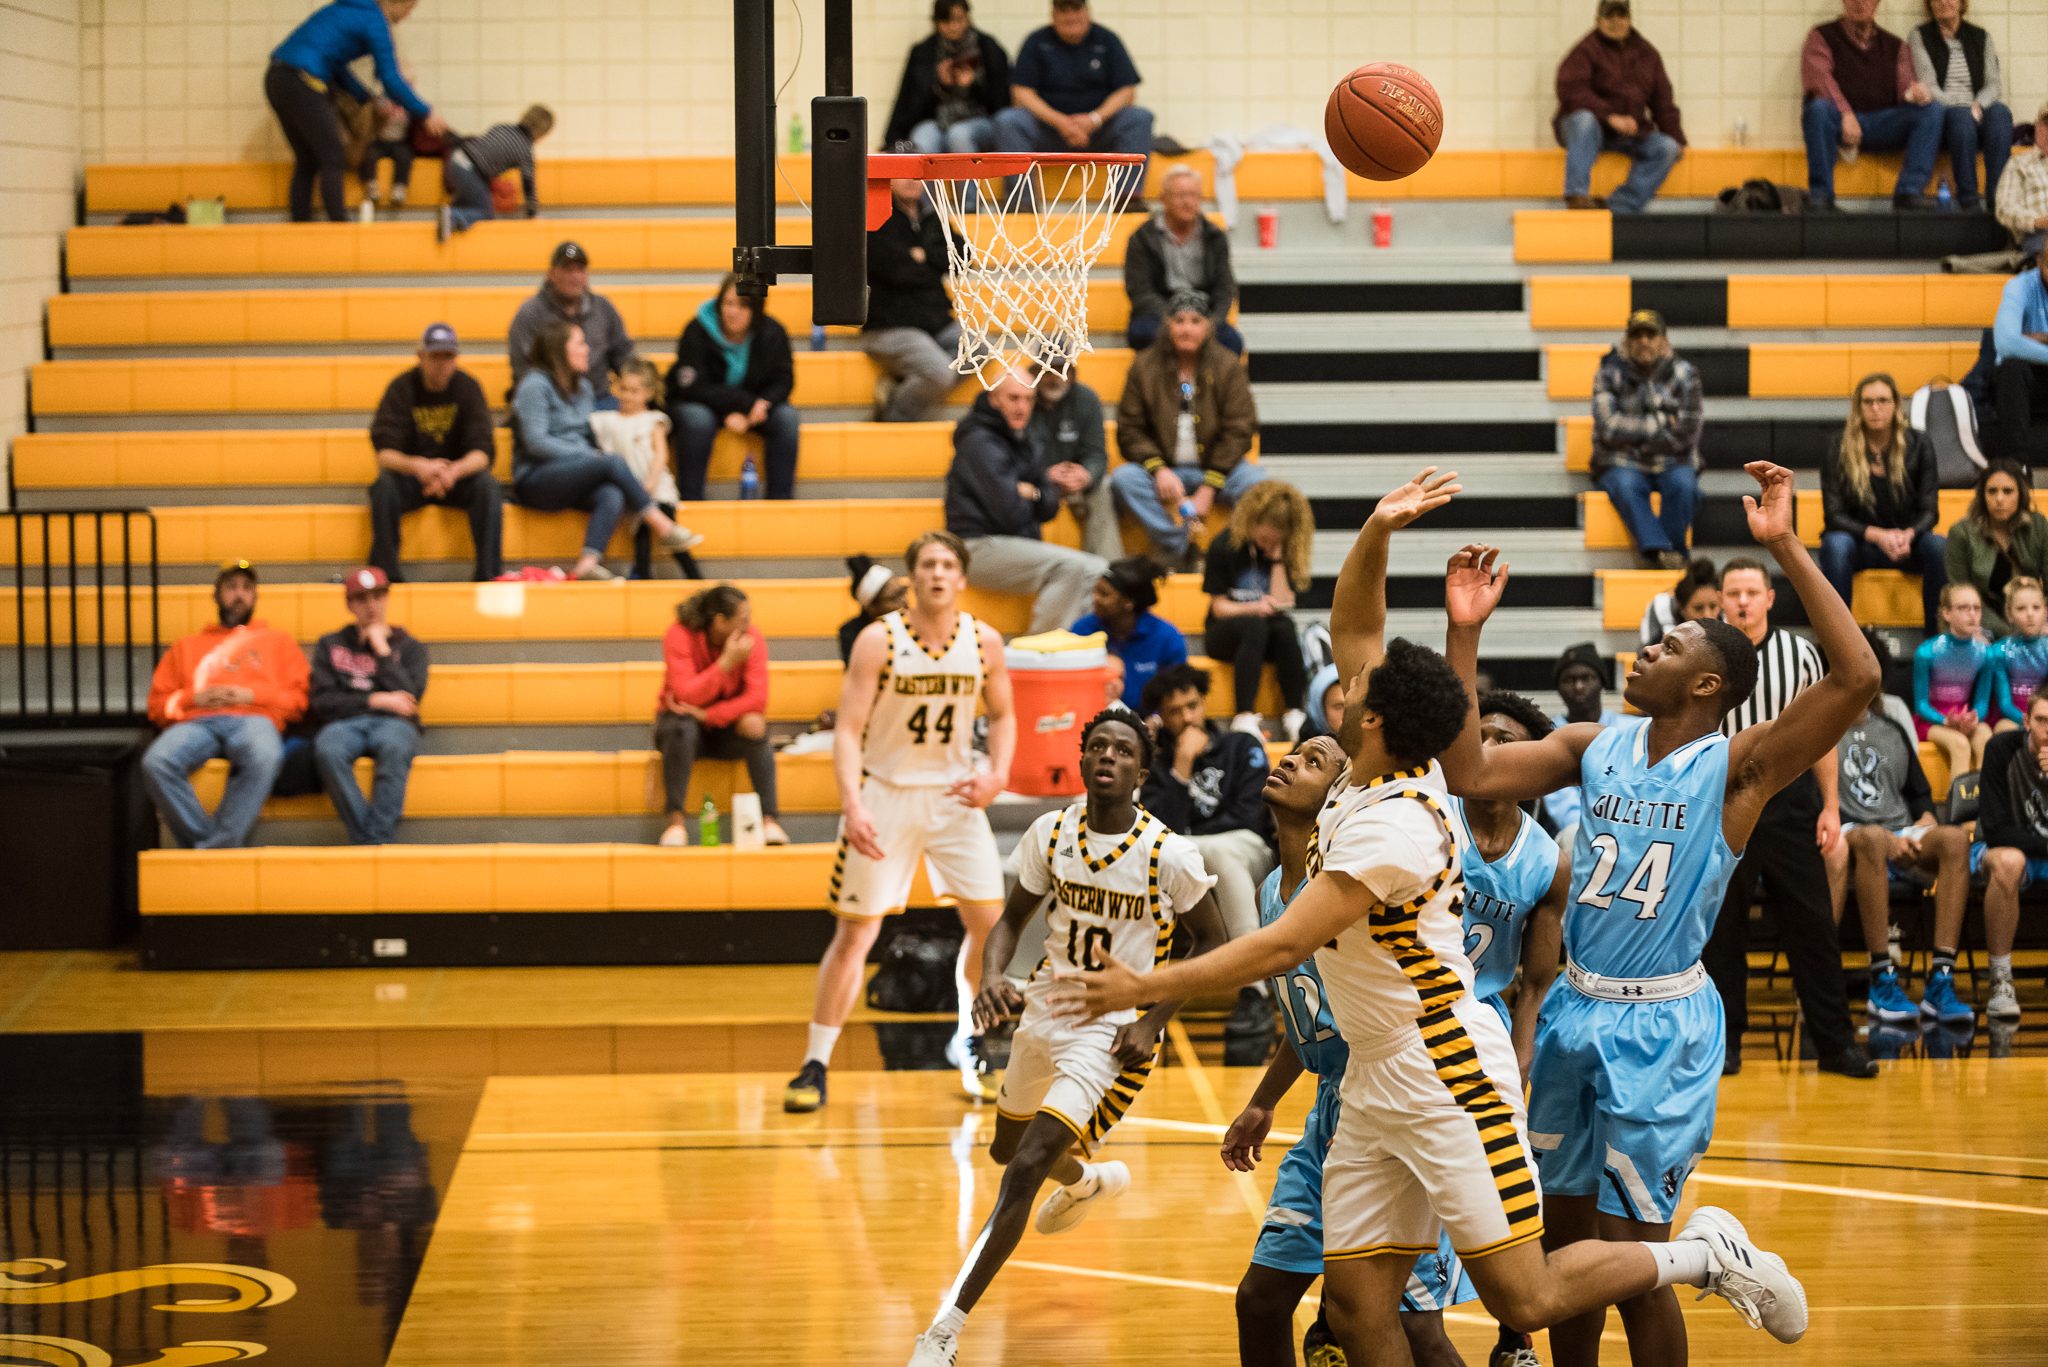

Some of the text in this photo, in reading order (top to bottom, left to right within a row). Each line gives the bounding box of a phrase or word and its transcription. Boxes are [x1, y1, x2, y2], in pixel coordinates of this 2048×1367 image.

[907, 704, 954, 744] 44
[1592, 794, 1687, 831] GILLETTE
[1576, 832, 1675, 920] 24
[1107, 889, 1145, 920] WYO
[1466, 889, 1516, 923] ETTE
[1067, 919, 1112, 972] 10
[1273, 972, 1337, 1046] 12
